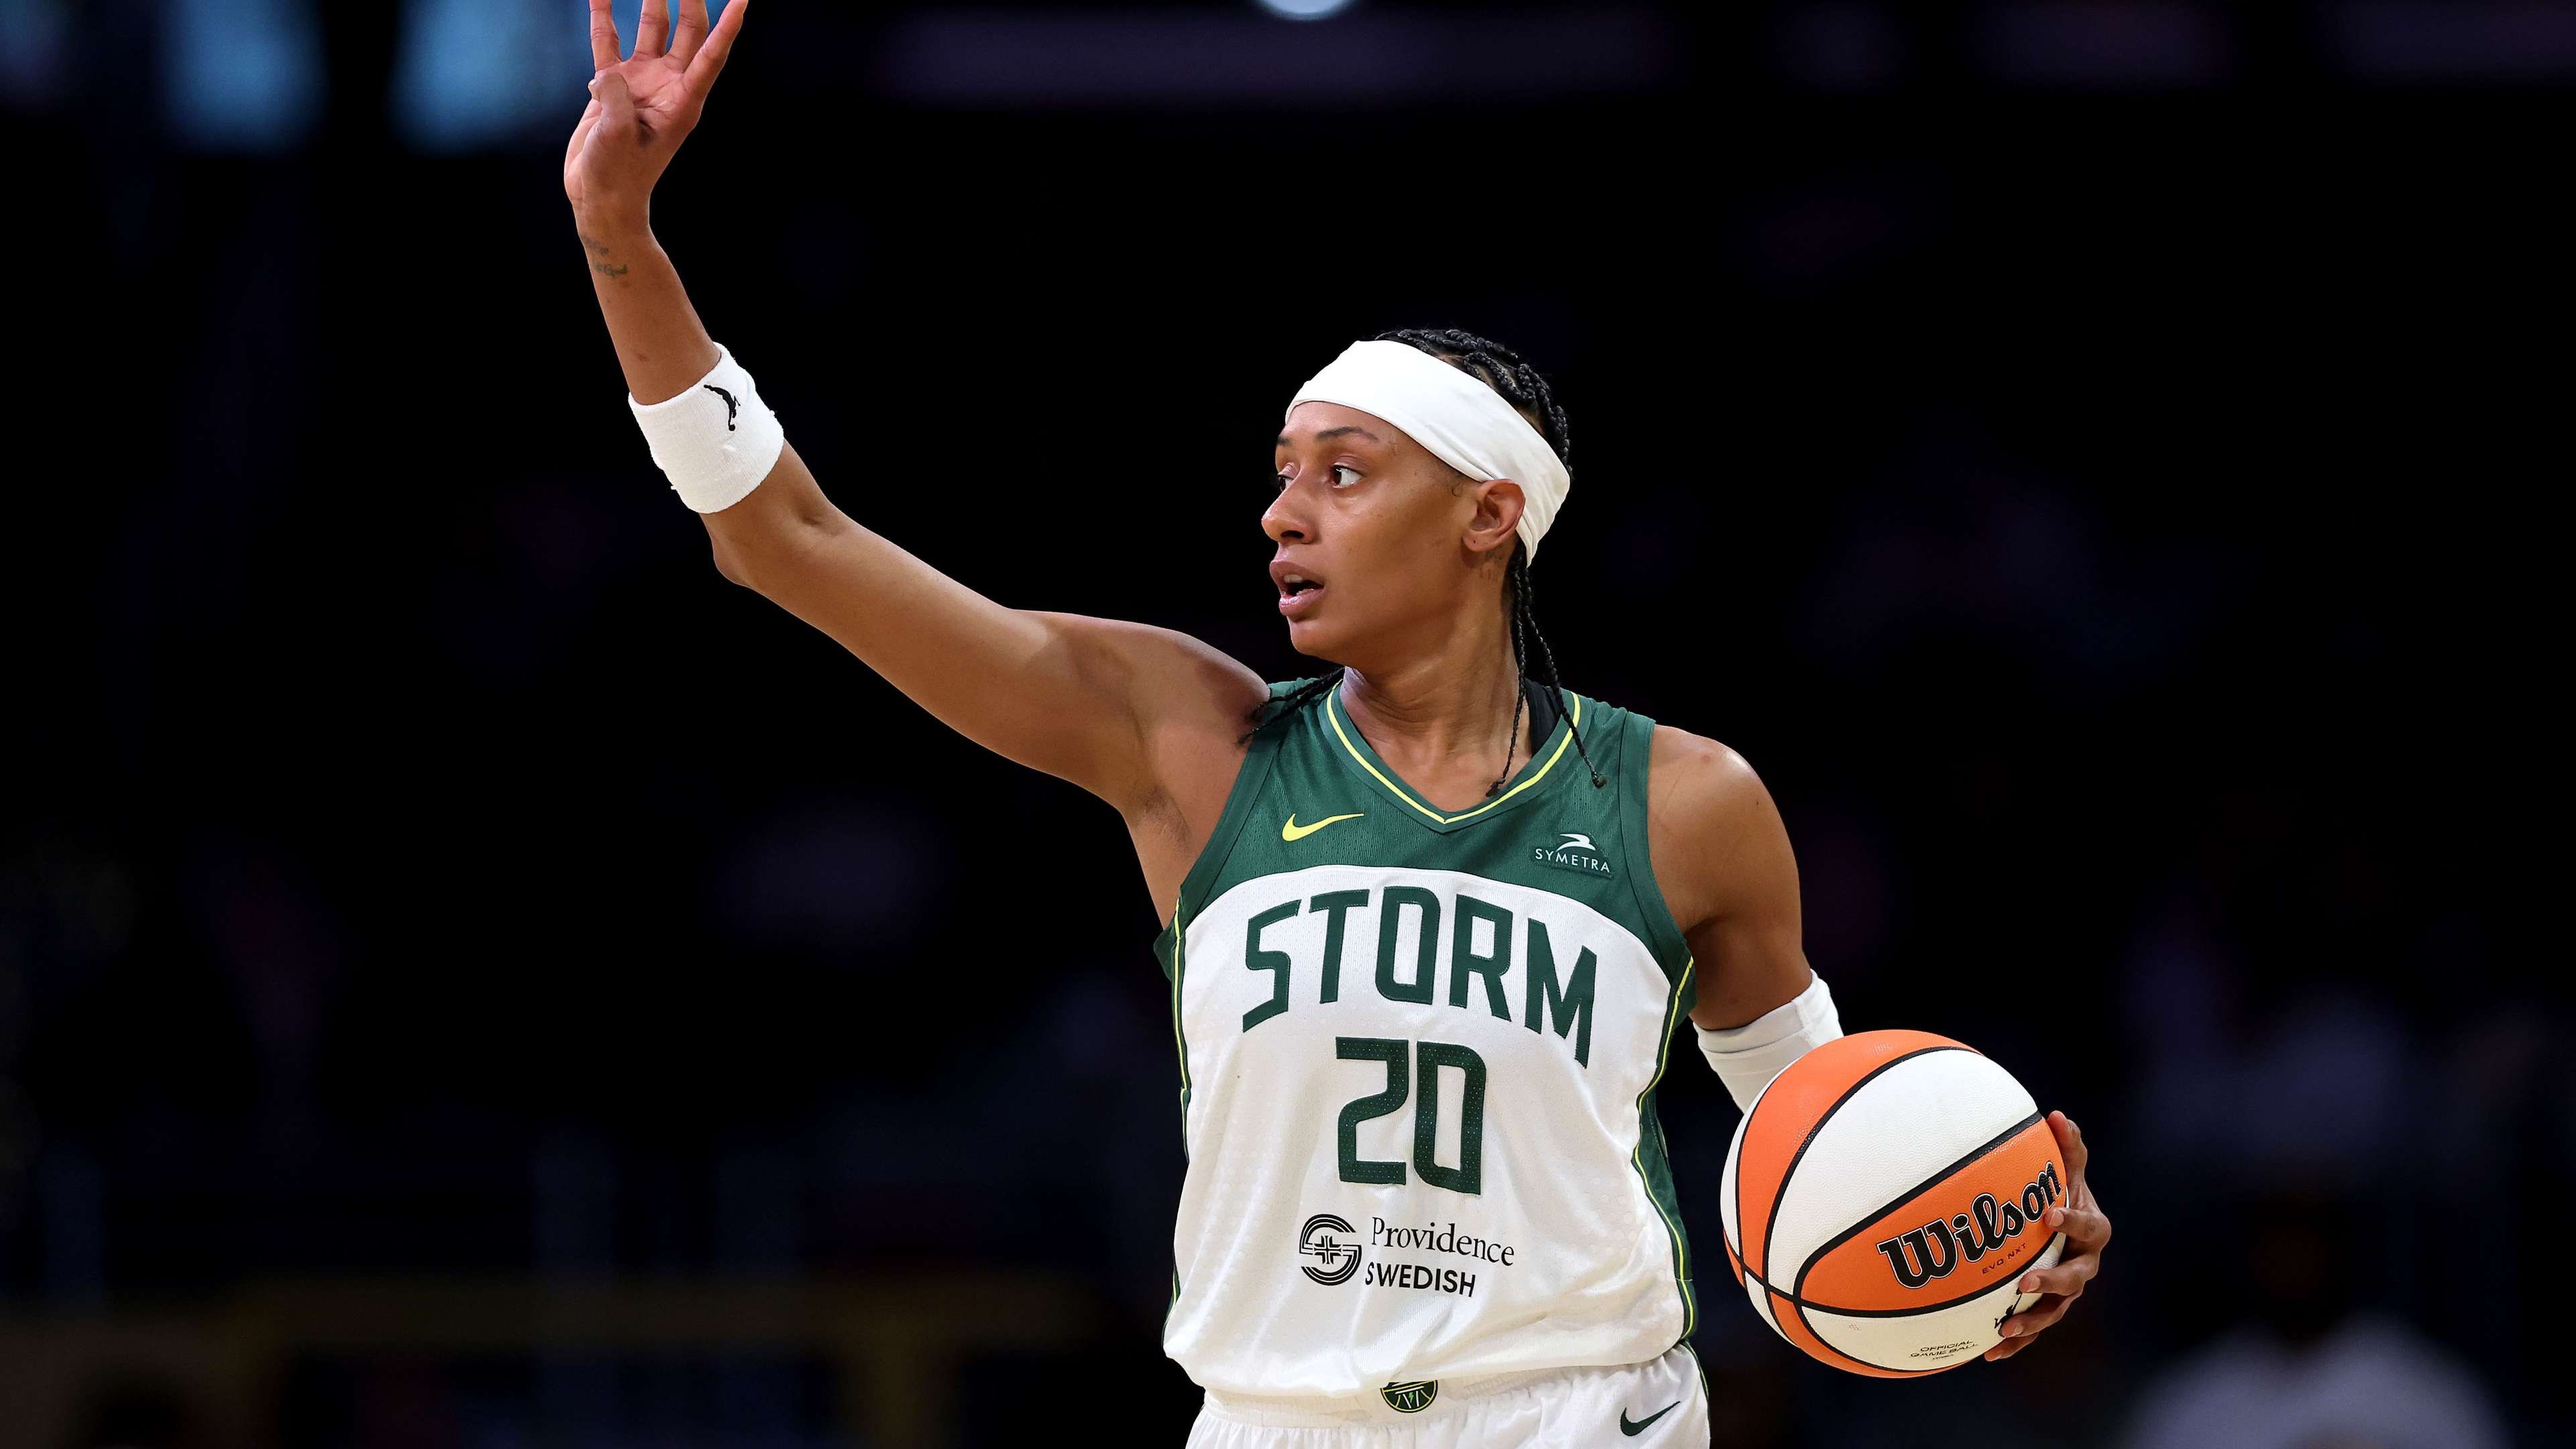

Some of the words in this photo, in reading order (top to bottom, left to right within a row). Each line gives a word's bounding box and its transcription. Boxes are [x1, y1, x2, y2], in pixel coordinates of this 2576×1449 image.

[1535, 848, 1610, 873] SYMETRA
[1242, 885, 1597, 1069] STORM
[1336, 1036, 1487, 1195] 20
[1371, 1216, 1515, 1267] Providence
[1876, 1161, 2061, 1289] Wilson
[1982, 1258, 2004, 1275] EVO
[2007, 1242, 2027, 1259] NXT
[1365, 1261, 1476, 1297] SWEDISH
[1920, 1340, 1974, 1352] OFFICIAL
[1949, 1344, 1978, 1353] BALL
